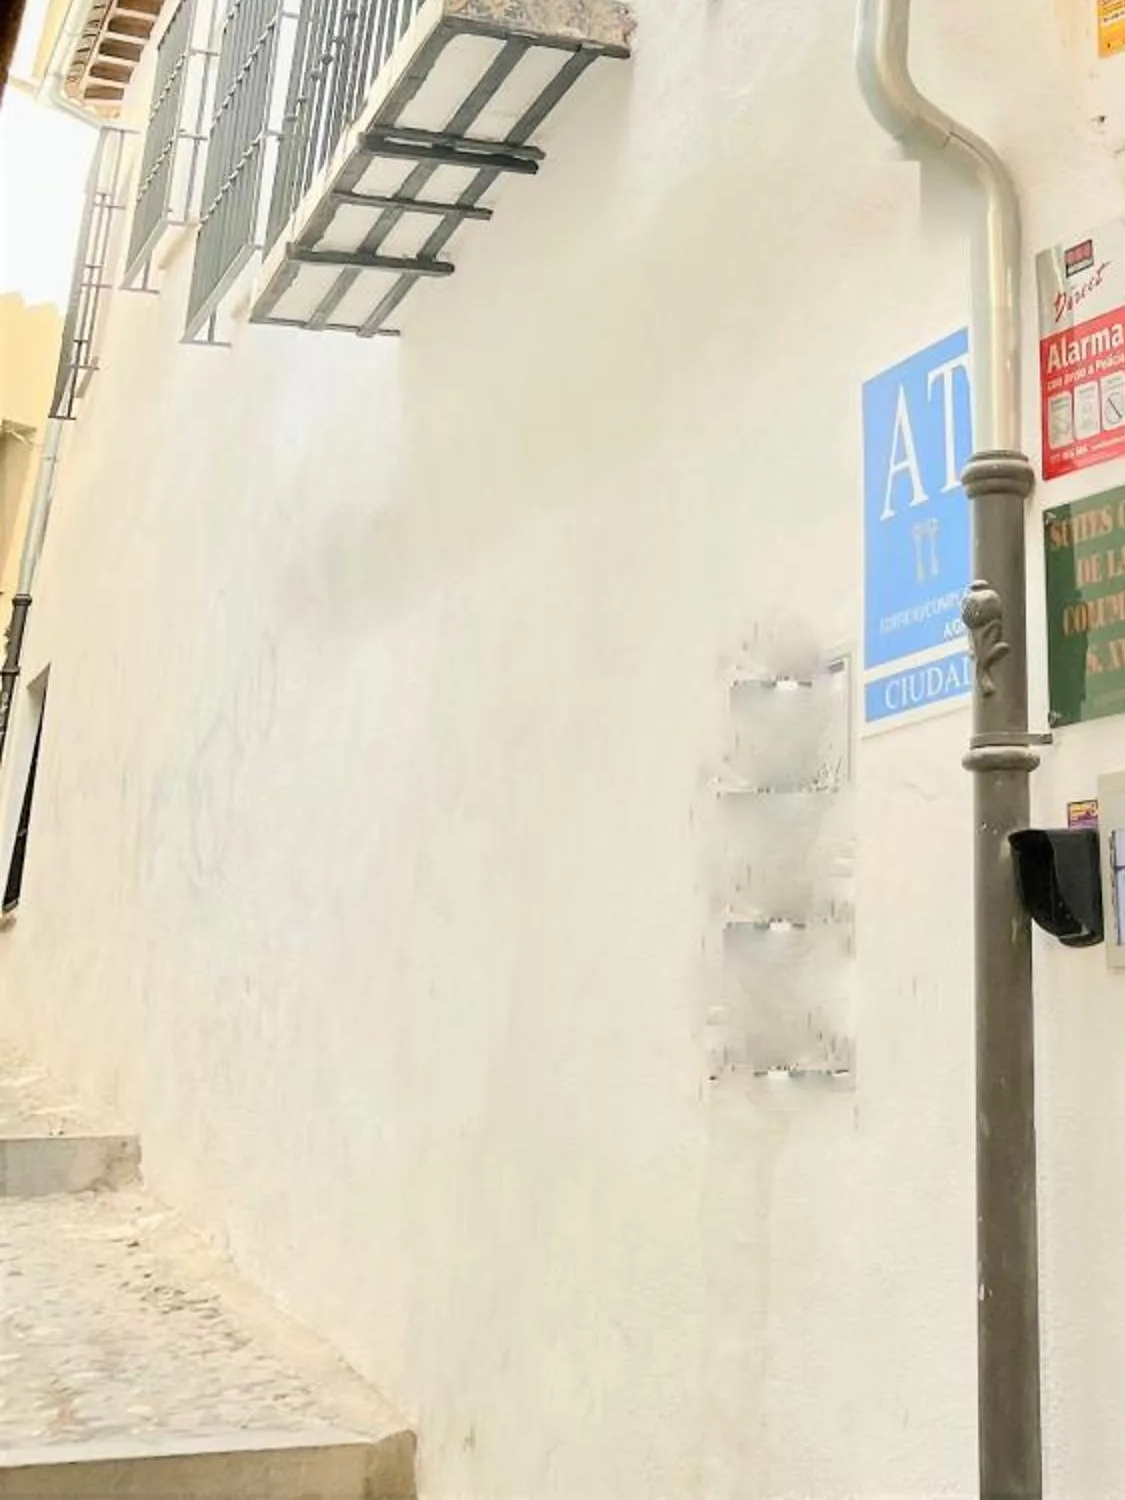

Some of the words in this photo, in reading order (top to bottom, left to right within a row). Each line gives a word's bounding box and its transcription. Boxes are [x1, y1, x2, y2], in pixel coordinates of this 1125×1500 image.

[1047, 323, 1125, 374] Alarma
[879, 352, 974, 523] AT
[1050, 504, 1113, 548] SUITES
[1076, 555, 1104, 588] DE
